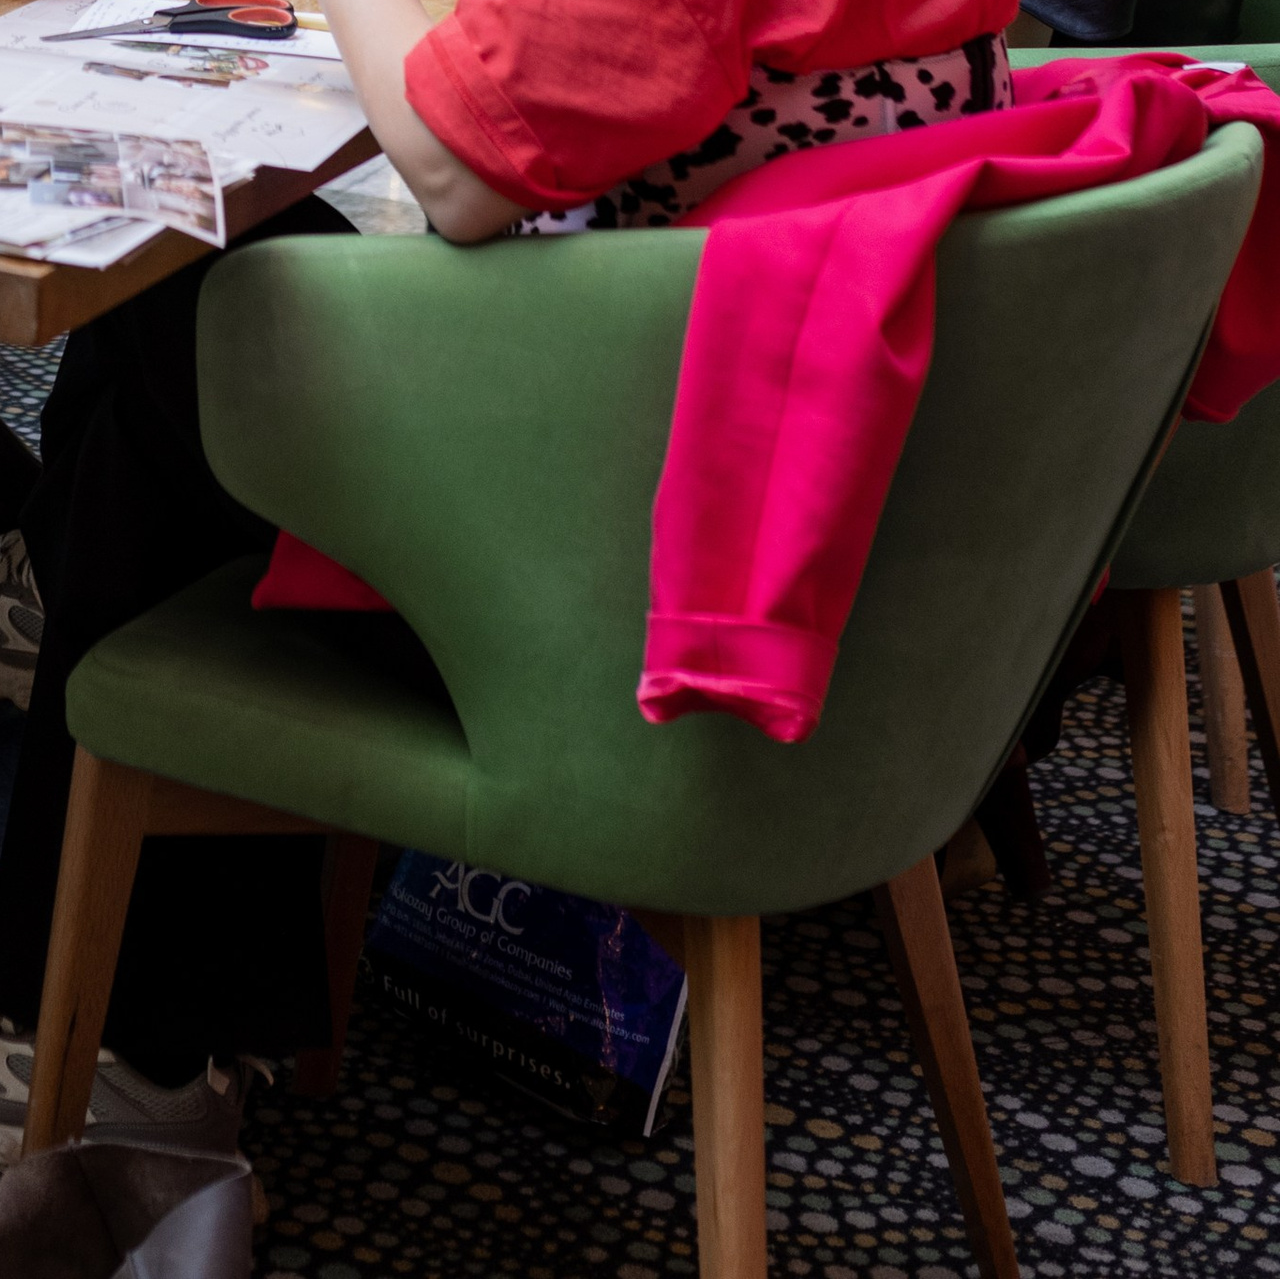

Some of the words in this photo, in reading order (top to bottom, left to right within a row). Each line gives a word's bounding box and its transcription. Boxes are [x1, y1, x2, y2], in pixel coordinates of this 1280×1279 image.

[428, 860, 532, 935] AGC
[436, 907, 476, 939] Group
[480, 930, 496, 945] of
[497, 935, 573, 981] Companies
[535, 975, 562, 997] United
[563, 990, 582, 1006] Arab
[569, 1010, 650, 1044] www.aloozay.com
[383, 974, 420, 1010] Full
[428, 1006, 447, 1025] of
[456, 1021, 571, 1089] surprises.
